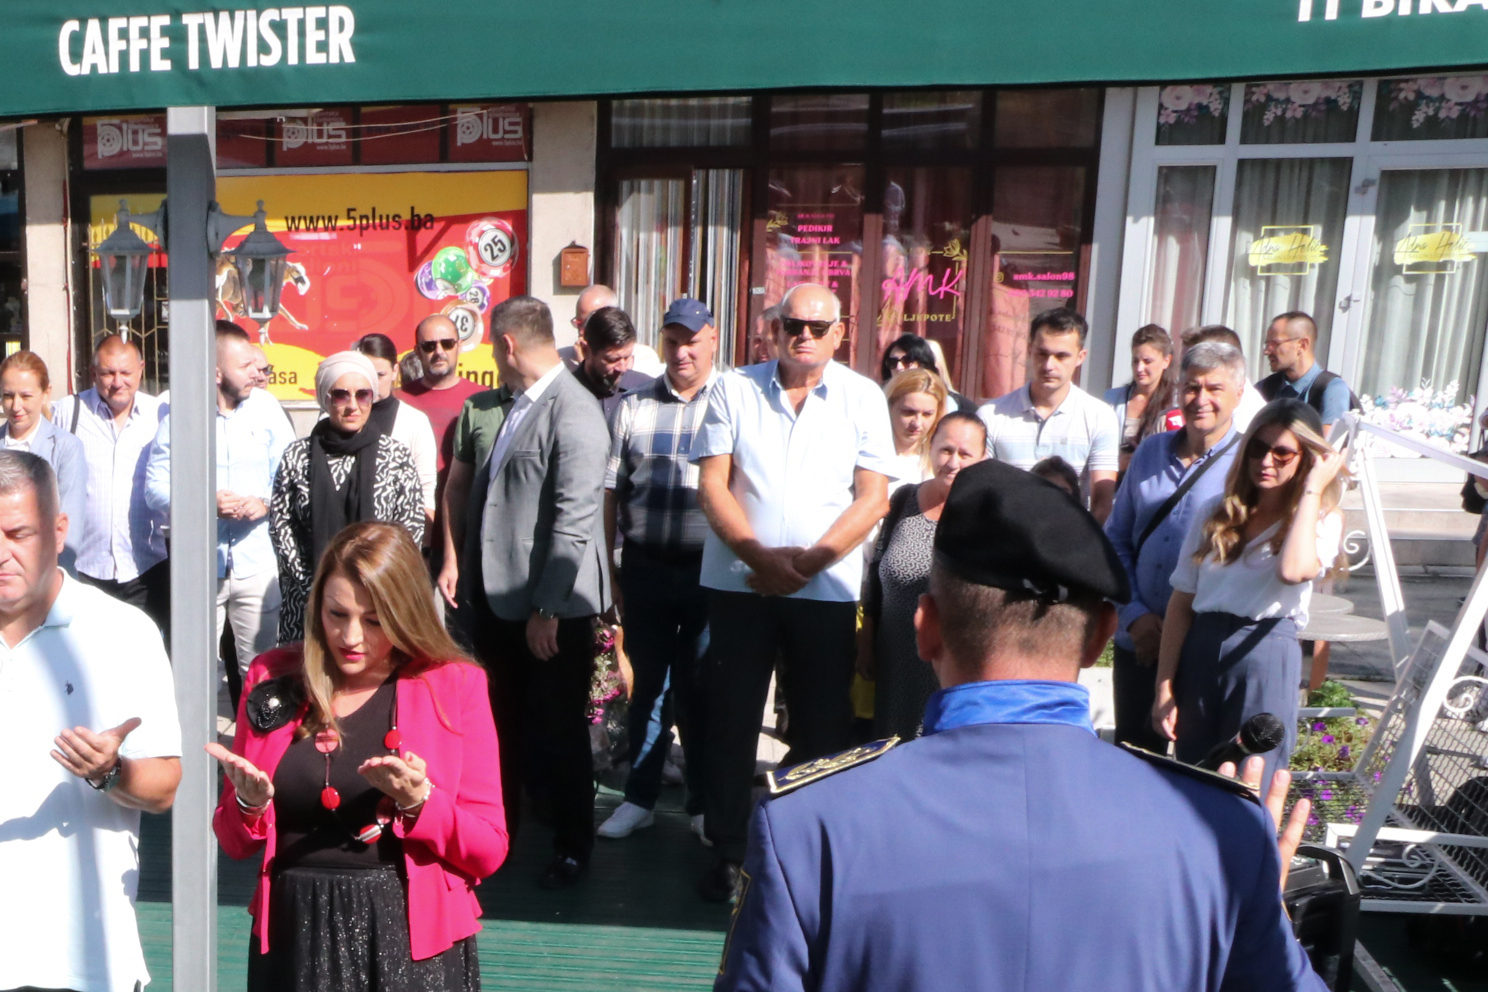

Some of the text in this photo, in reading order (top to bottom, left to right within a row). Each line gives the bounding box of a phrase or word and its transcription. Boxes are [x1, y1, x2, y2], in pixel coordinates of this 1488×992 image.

[58, 5, 356, 77] CAFFE TWISTER
[285, 206, 435, 237] www.5plus.ba
[797, 224, 833, 233] PEDIKIR
[484, 234, 508, 262] 25
[822, 236, 841, 245] LAK
[1013, 272, 1076, 281] amk.salon98
